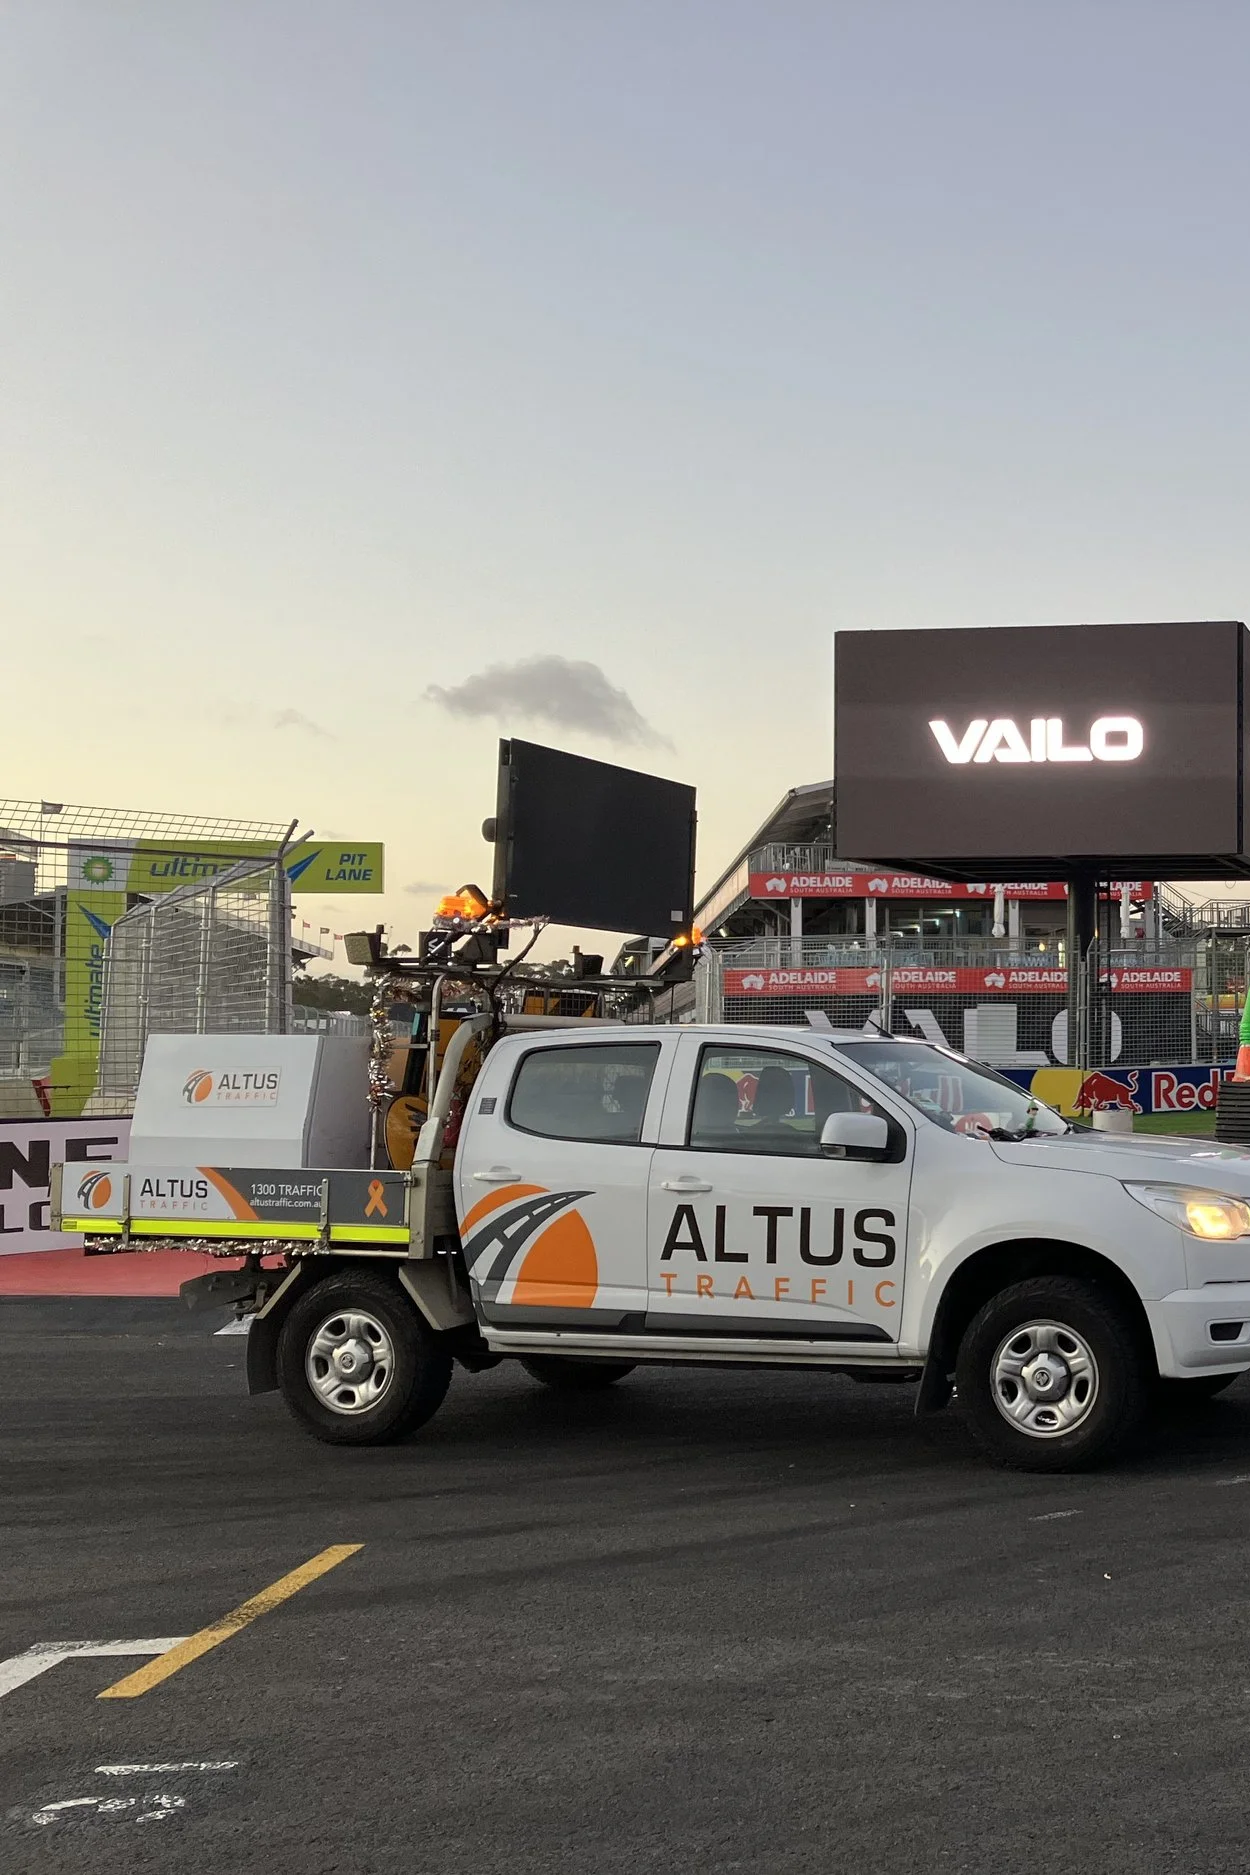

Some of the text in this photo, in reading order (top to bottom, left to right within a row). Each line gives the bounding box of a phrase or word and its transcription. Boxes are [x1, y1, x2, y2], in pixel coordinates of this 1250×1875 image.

[928, 717, 1144, 764] VAILO
[339, 853, 367, 866] PIT
[325, 868, 373, 881] LANE
[790, 876, 853, 888] ADELAIDE
[768, 972, 837, 984] ADELAIDE
[891, 971, 957, 983] ADELAIDE
[1121, 971, 1181, 983] ADELAIDE
[217, 1073, 278, 1089] ALTUS
[216, 1092, 276, 1100] TRAFFIC
[140, 1178, 208, 1198] ALTUS
[251, 1183, 276, 1195] 1300
[140, 1200, 208, 1211] TRAFFIC
[660, 1204, 897, 1268] ALTUS
[660, 1273, 897, 1308] TRAFFIC
